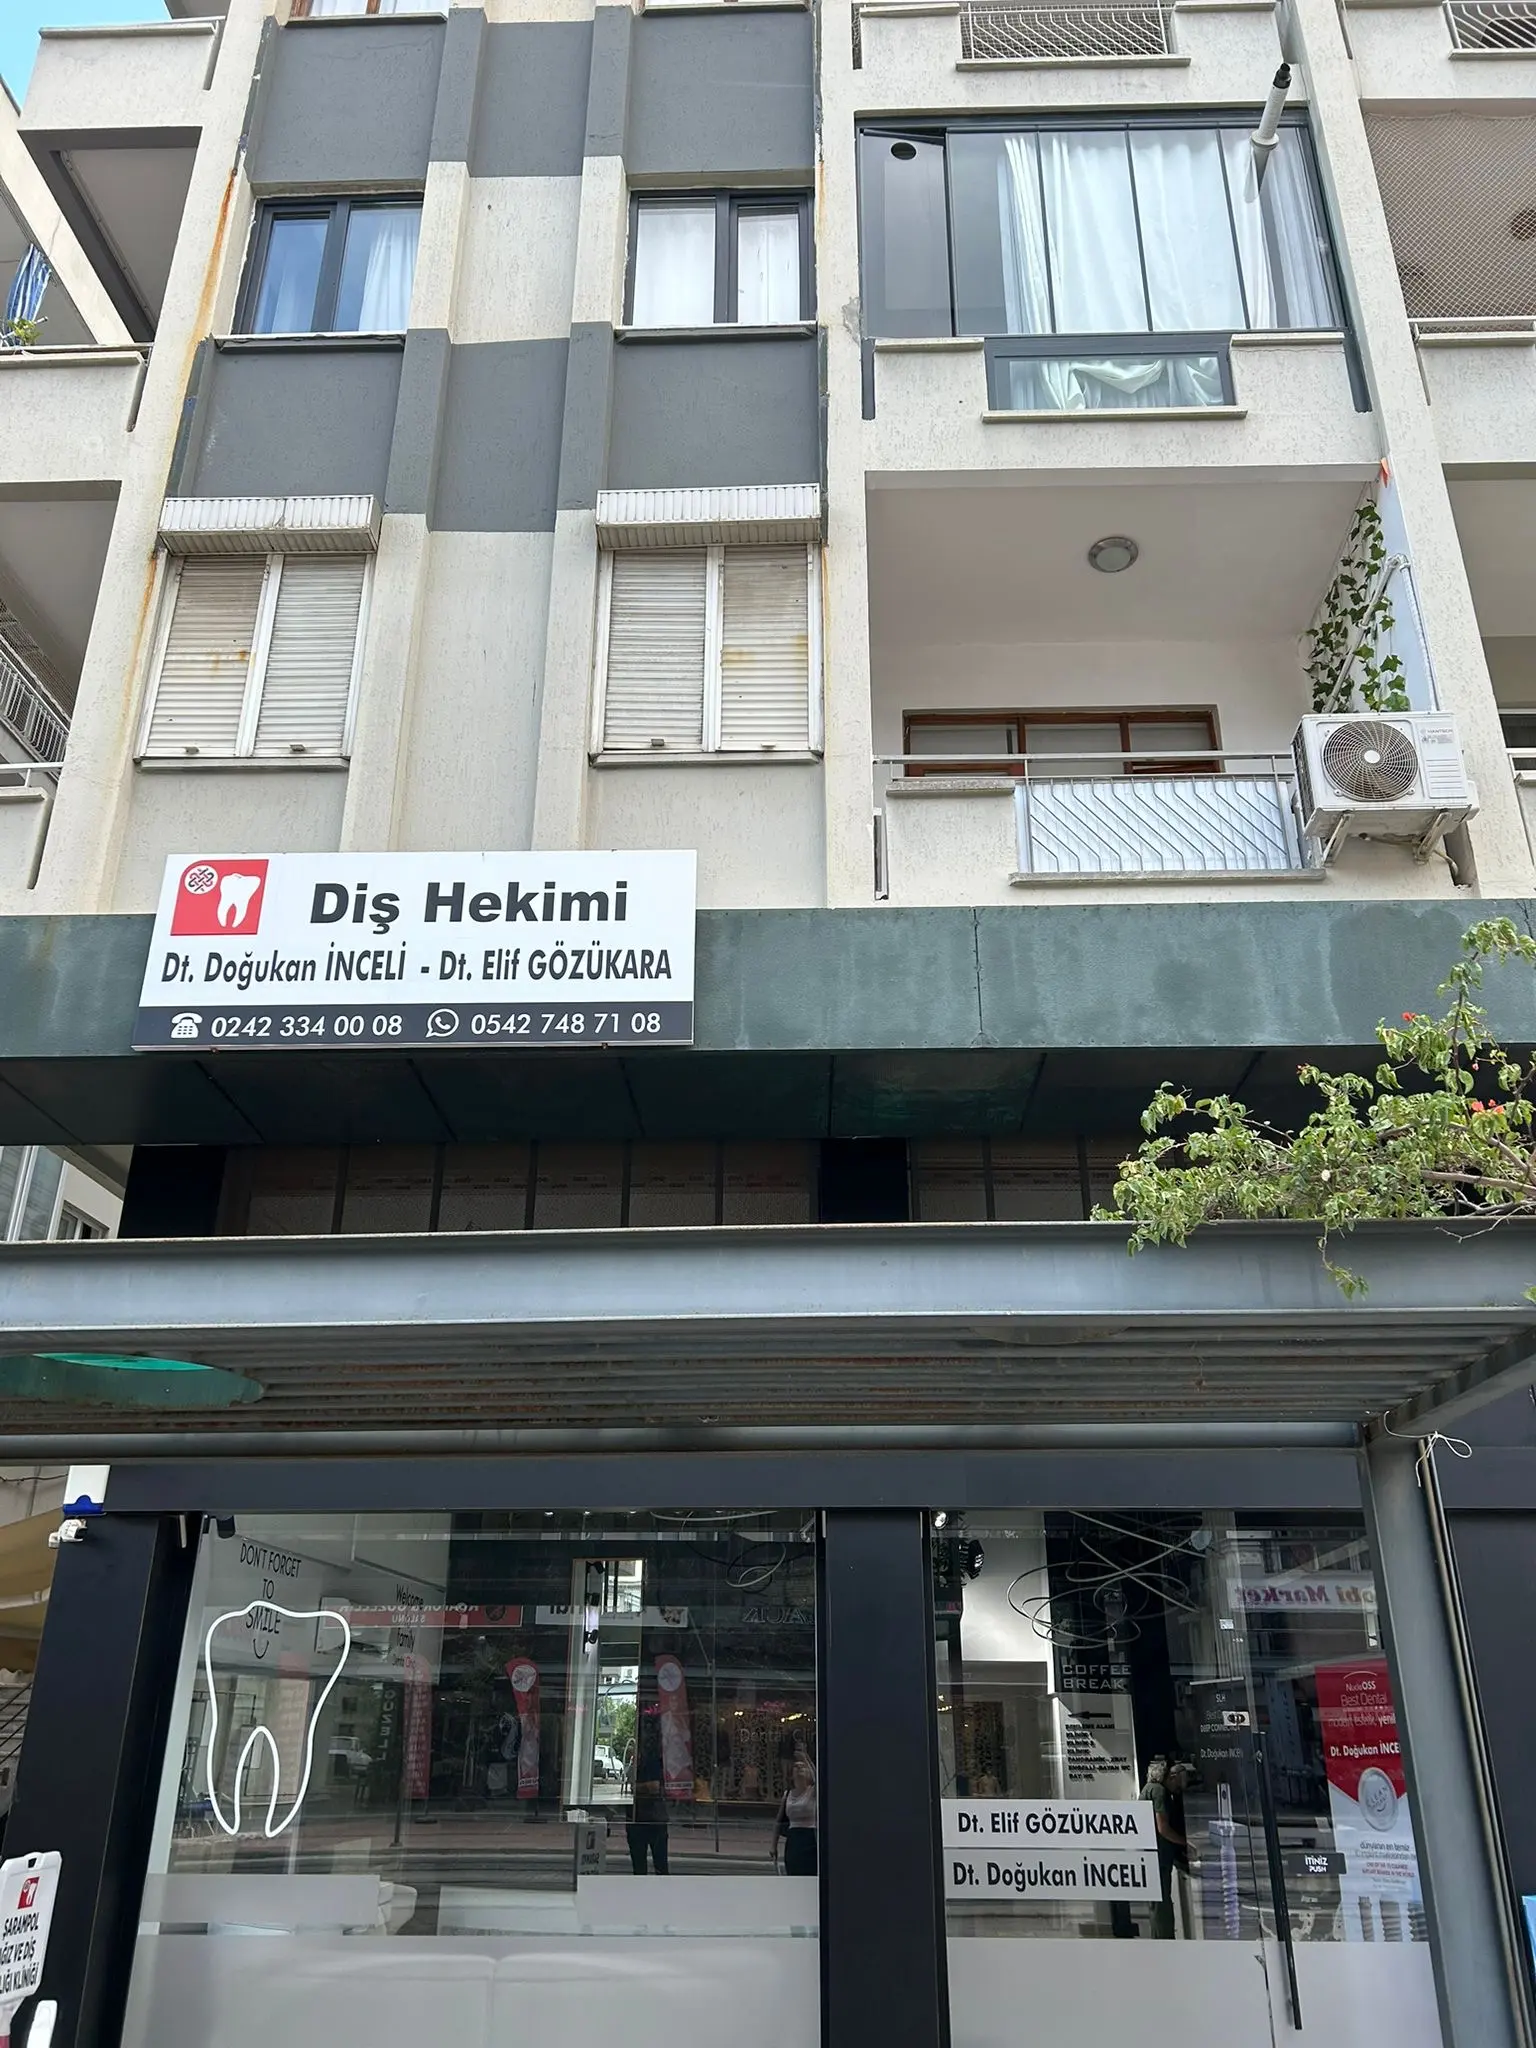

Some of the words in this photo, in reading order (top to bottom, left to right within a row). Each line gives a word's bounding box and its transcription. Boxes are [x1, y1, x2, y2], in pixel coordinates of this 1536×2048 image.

[310, 882, 401, 934] Diş
[424, 880, 629, 924] Hekimi
[161, 953, 195, 983] Dt.
[204, 950, 316, 991] Doğukan
[325, 942, 407, 982] İNCELİ
[439, 951, 473, 981] Dt.
[482, 948, 520, 981] Elif
[527, 941, 673, 980] GÖZÜKARA
[210, 1015, 274, 1037] 0242
[279, 1014, 325, 1037] 334
[333, 1014, 365, 1036] 00
[371, 1014, 403, 1036] 08
[470, 1013, 534, 1035] 0542
[540, 1013, 584, 1034] 748
[593, 1013, 621, 1034] 71
[630, 1013, 662, 1033] 08
[268, 1551, 302, 1578] FORGET
[263, 1579, 275, 1599] TO
[1062, 1664, 1132, 1675] COFFEE
[1063, 1678, 1126, 1690] BREAK
[1361, 1691, 1388, 1706] Dental
[1343, 1744, 1379, 1759] Doğukan
[1380, 1740, 1401, 1755] İNCE
[958, 1812, 985, 1834] Dt.
[990, 1811, 1020, 1834] Elif
[1025, 1806, 1139, 1835] GÖZÜKARA
[1304, 1854, 1329, 1866] İTİNİZ
[1308, 1865, 1327, 1873] PUSH
[953, 1863, 980, 1886] Dt.
[986, 1860, 1077, 1893] Doğukan
[1082, 1856, 1148, 1889] İNCELİ
[2, 1911, 40, 1940] ŞARAMPOL
[13, 1942, 25, 1962] VE
[23, 1936, 36, 1961] DİŞ
